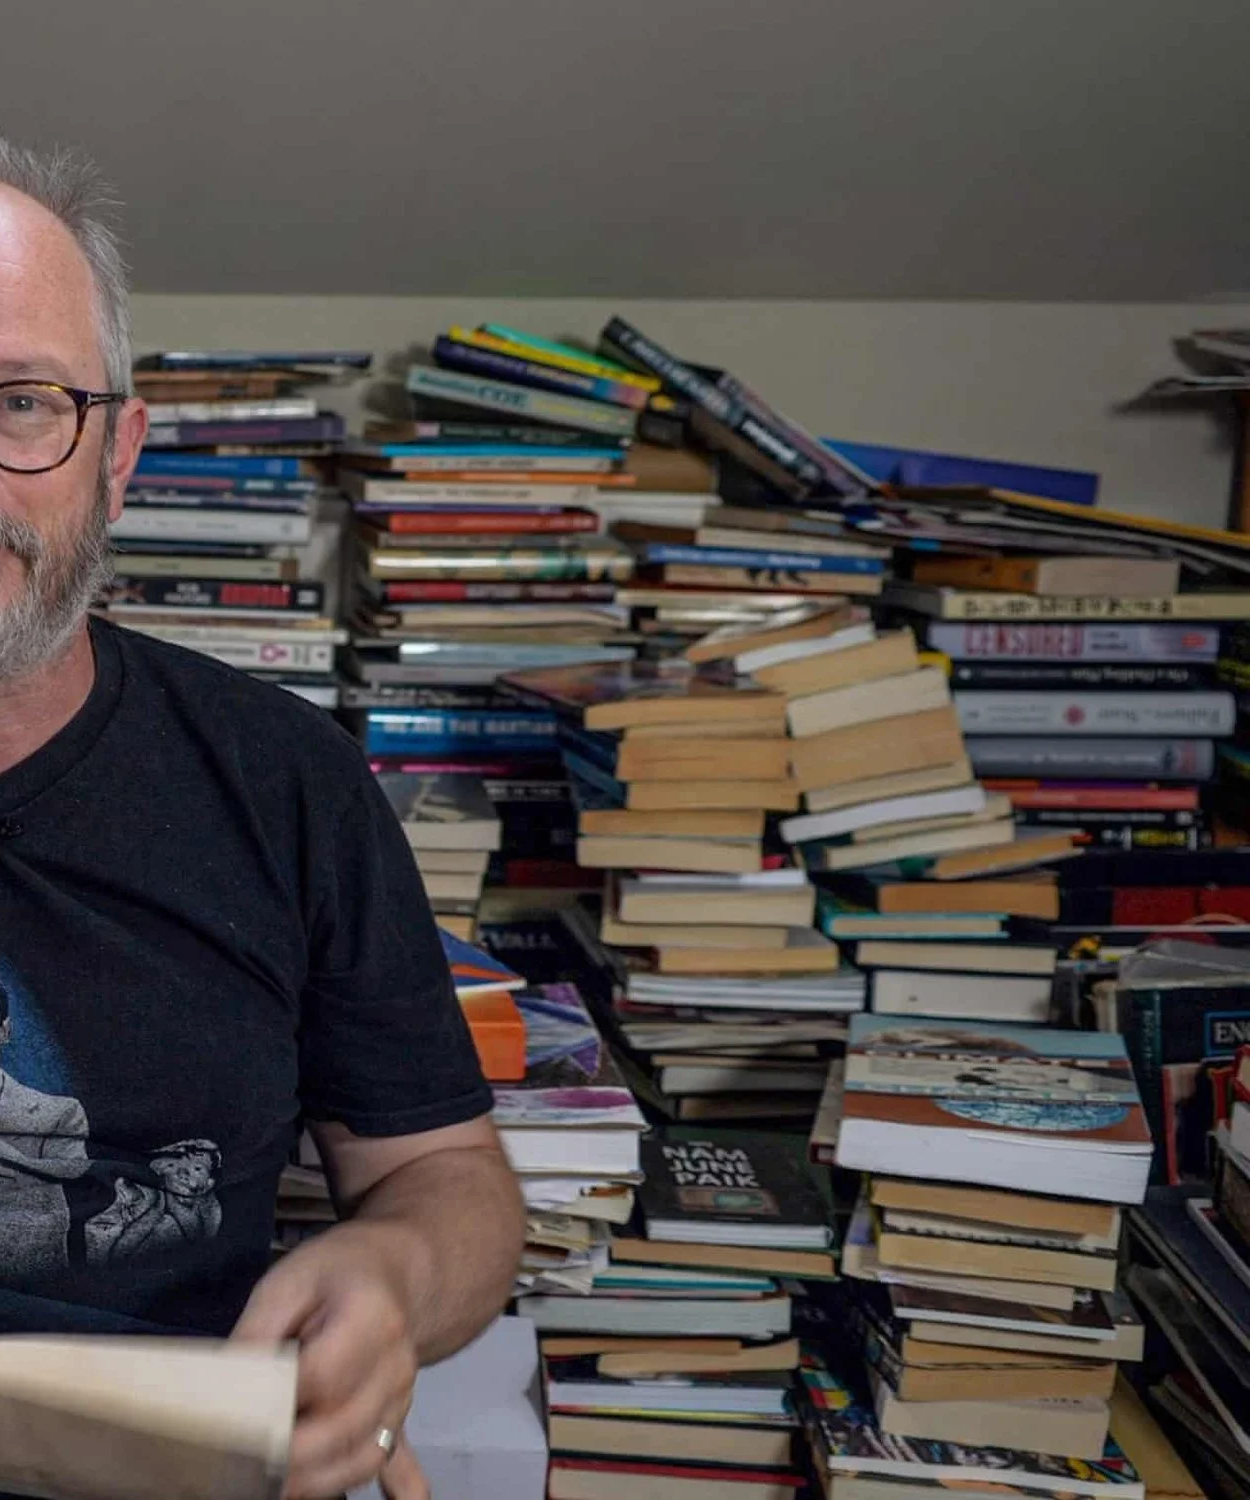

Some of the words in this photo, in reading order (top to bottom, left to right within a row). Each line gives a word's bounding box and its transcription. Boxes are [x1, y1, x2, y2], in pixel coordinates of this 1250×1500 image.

[662, 1145, 749, 1161] NAM
[668, 1160, 756, 1174] JUNE
[674, 1172, 761, 1187] PAIK
